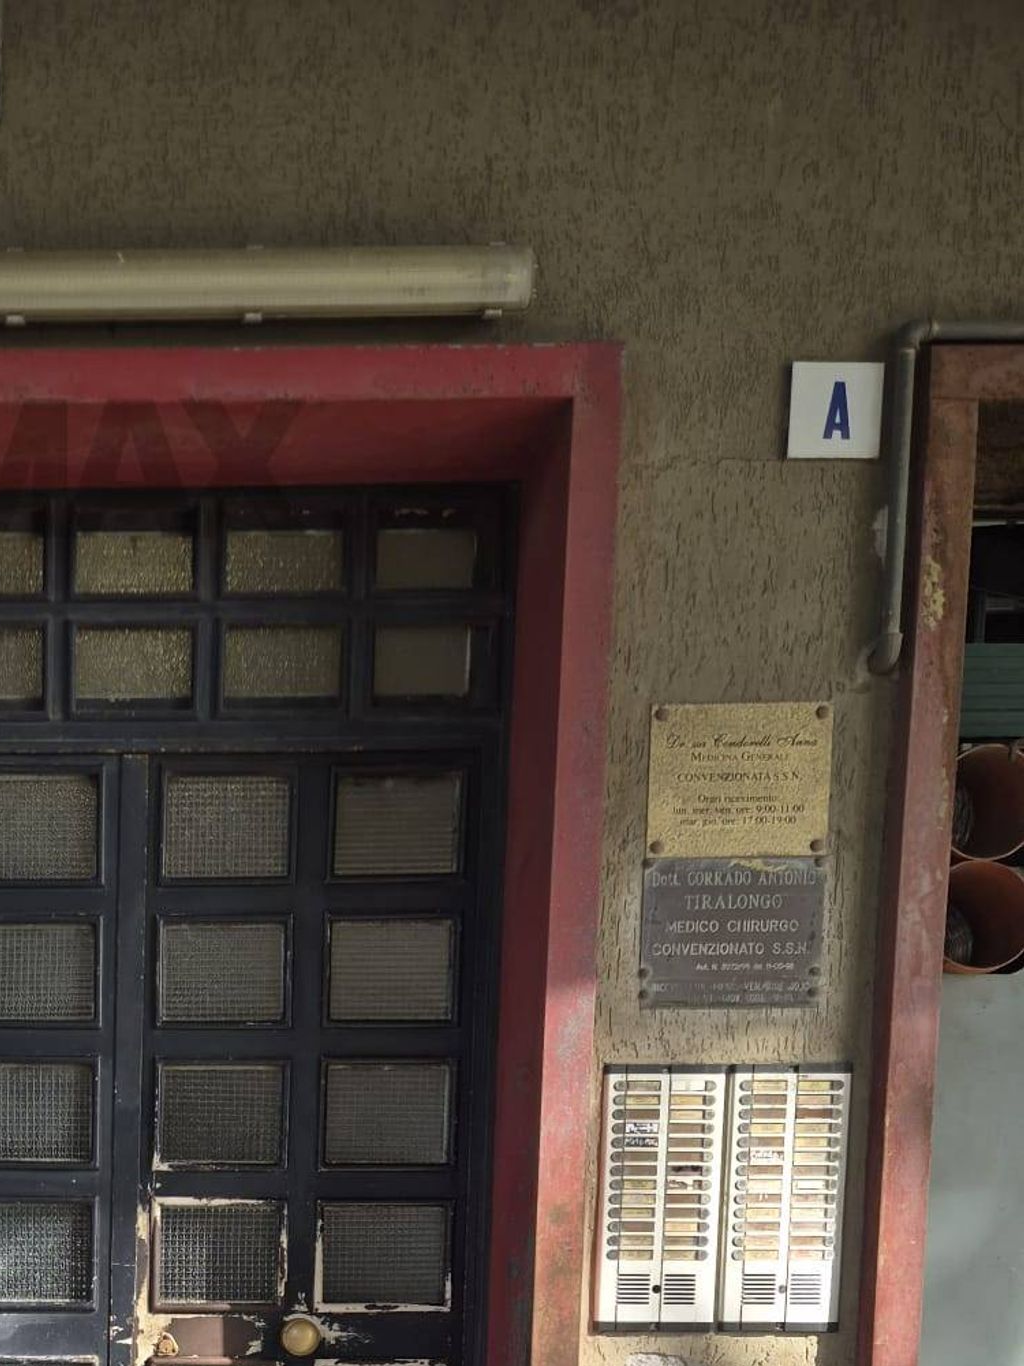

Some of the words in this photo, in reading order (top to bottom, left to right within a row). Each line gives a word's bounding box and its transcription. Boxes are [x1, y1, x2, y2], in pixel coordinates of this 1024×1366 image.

[822, 380, 851, 440] A
[687, 870, 752, 887] CORRADO
[757, 870, 817, 886] ANTONIO
[684, 893, 784, 910] TIRALONGO
[665, 918, 720, 933] MEDICO
[726, 918, 800, 933] CHIRURGO
[652, 942, 766, 957] CONVENZIONATO
